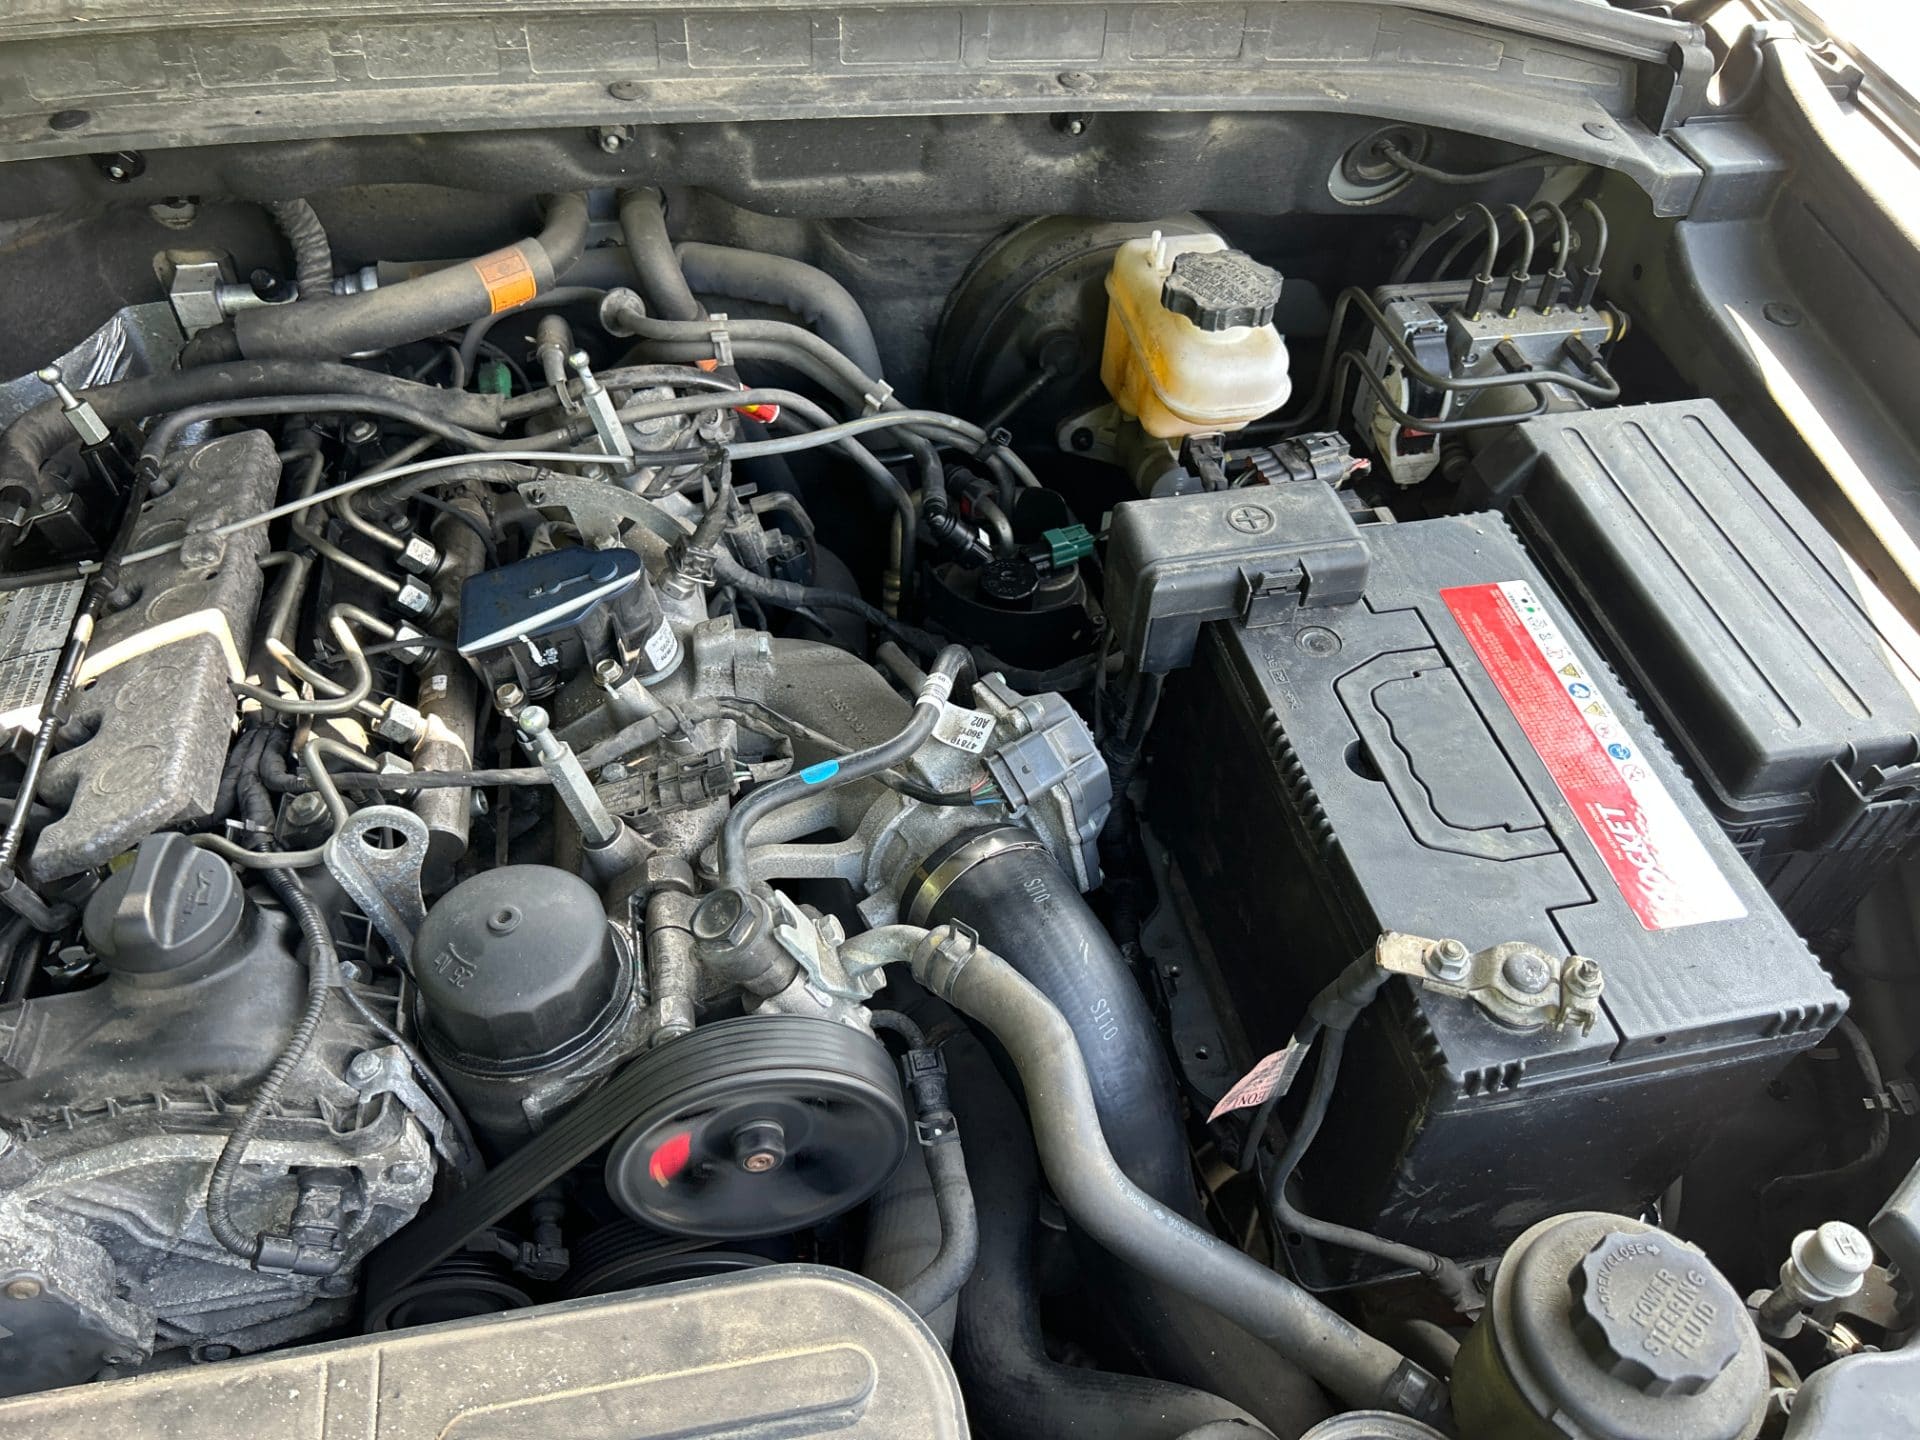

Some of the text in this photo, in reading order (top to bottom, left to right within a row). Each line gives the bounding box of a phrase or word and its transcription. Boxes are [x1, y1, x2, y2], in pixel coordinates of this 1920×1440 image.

[970, 715, 990, 729] A02
[1597, 1243, 1645, 1304] OPEN/CLOSE
[1834, 1235, 1857, 1256] H
[1628, 1268, 1677, 1329] POWER
[1641, 1269, 1706, 1358] STEERING
[1671, 1301, 1717, 1360] FLUID
